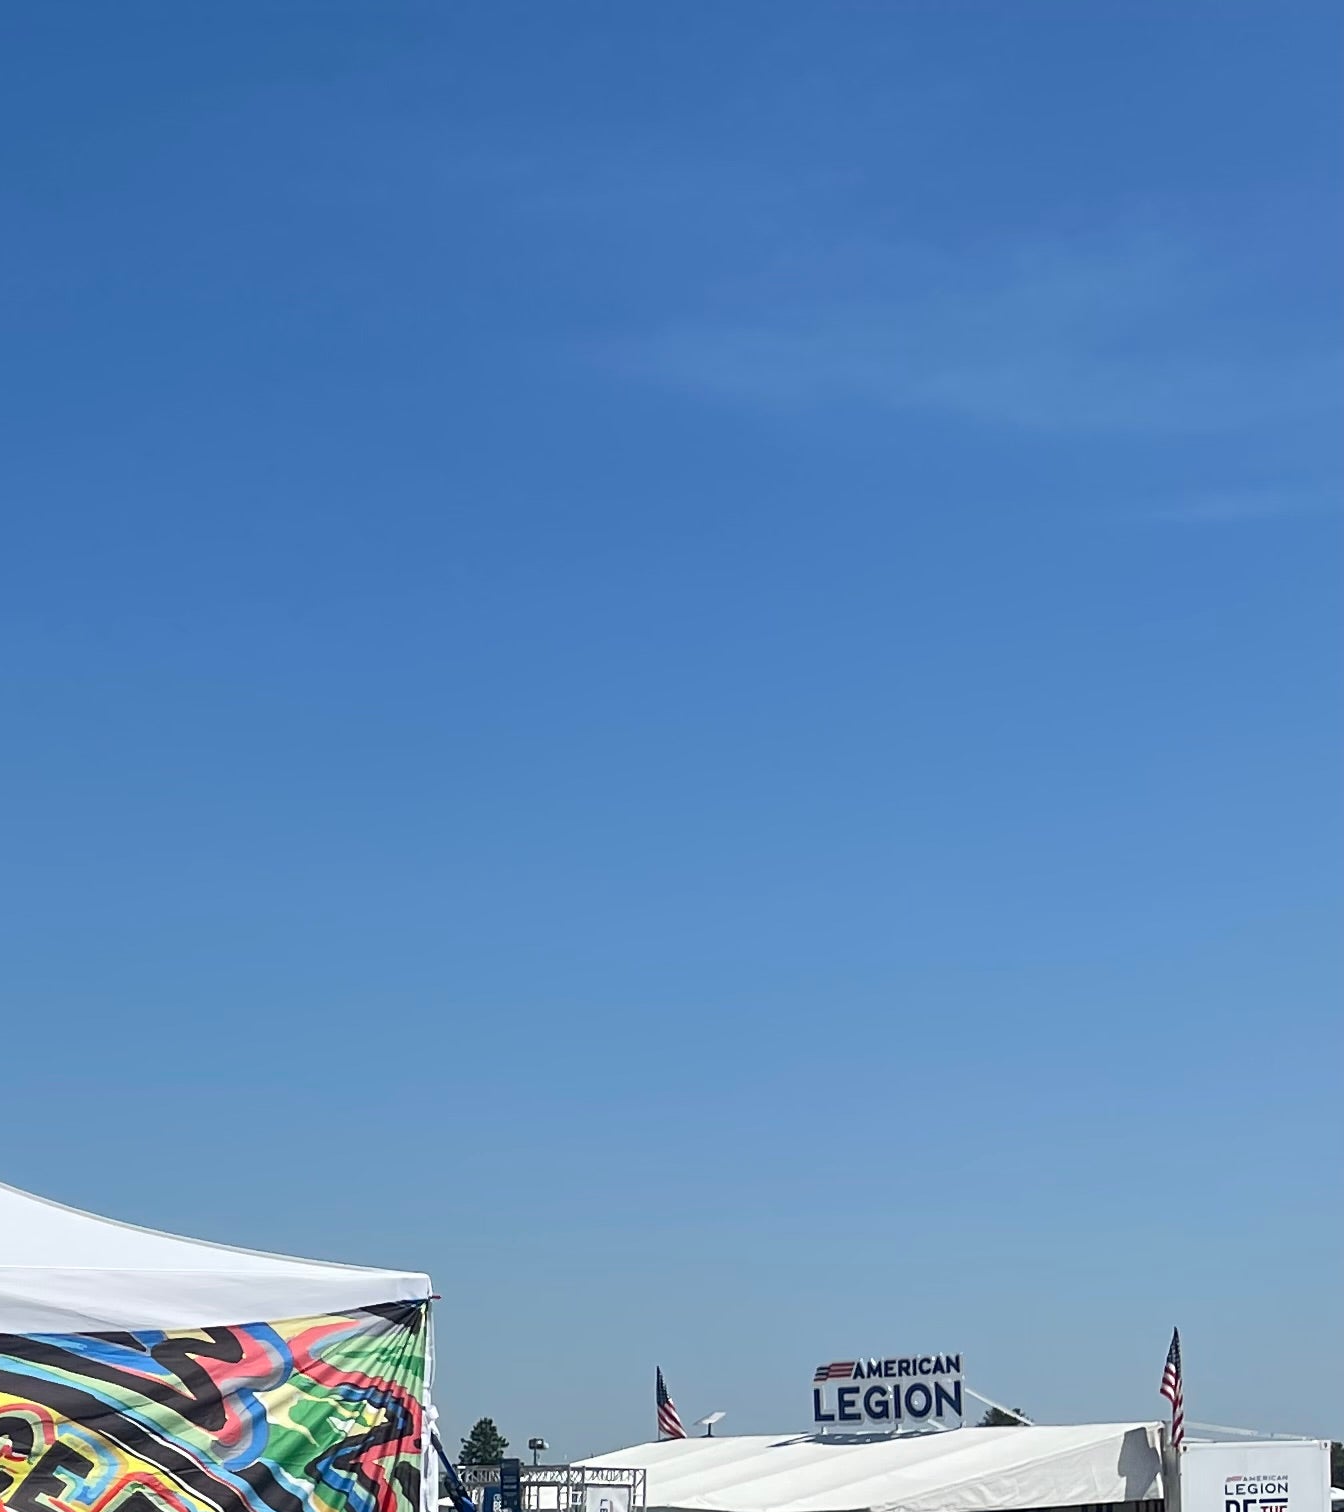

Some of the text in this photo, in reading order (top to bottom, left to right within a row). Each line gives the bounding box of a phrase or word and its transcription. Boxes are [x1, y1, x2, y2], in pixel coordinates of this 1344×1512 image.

[852, 1354, 961, 1380] AMERICAN
[813, 1380, 962, 1422] LEGION
[1224, 1482, 1289, 1496] LEGION
